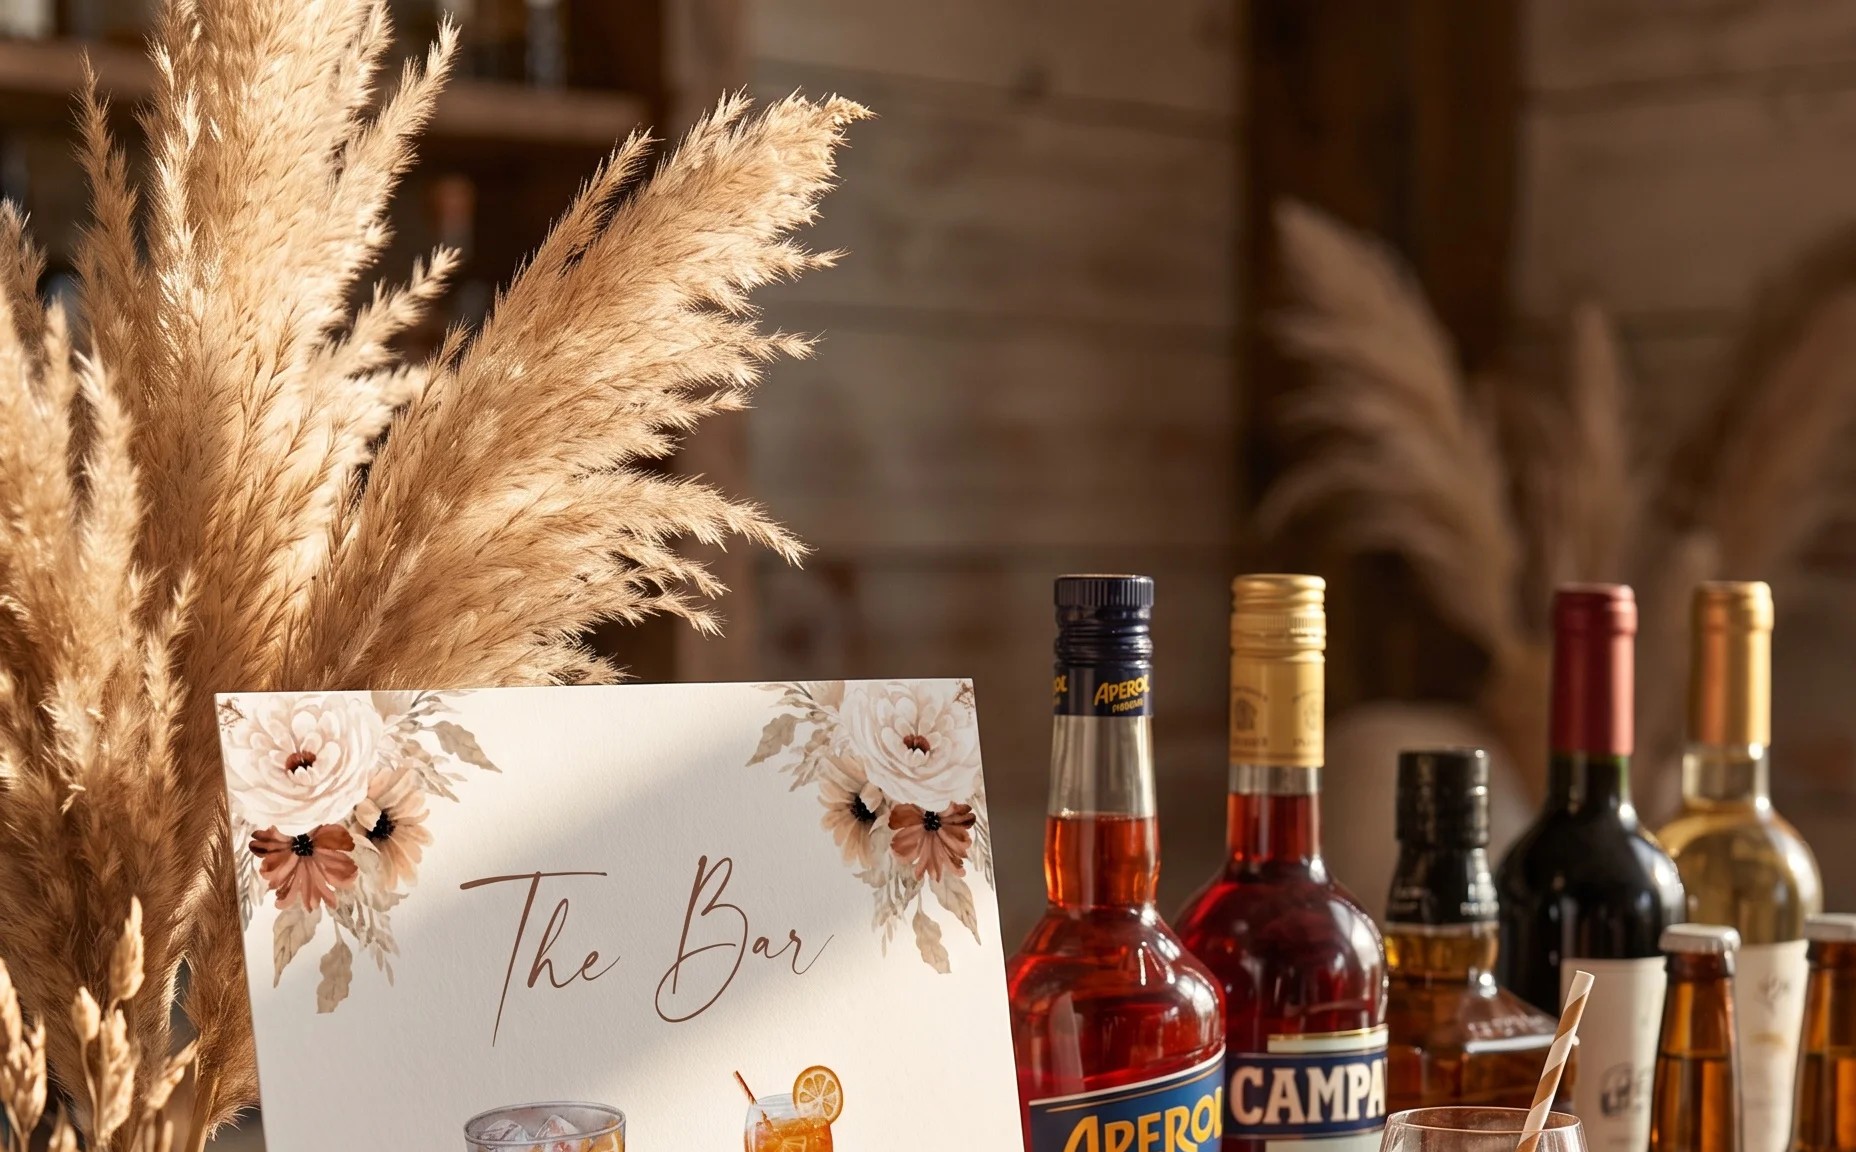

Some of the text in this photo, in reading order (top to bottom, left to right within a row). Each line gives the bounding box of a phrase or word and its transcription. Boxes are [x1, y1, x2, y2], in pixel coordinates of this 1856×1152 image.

[1094, 674, 1150, 706] APEROL
[459, 855, 835, 1047] The Bar
[1230, 1057, 1388, 1126] CAMPA
